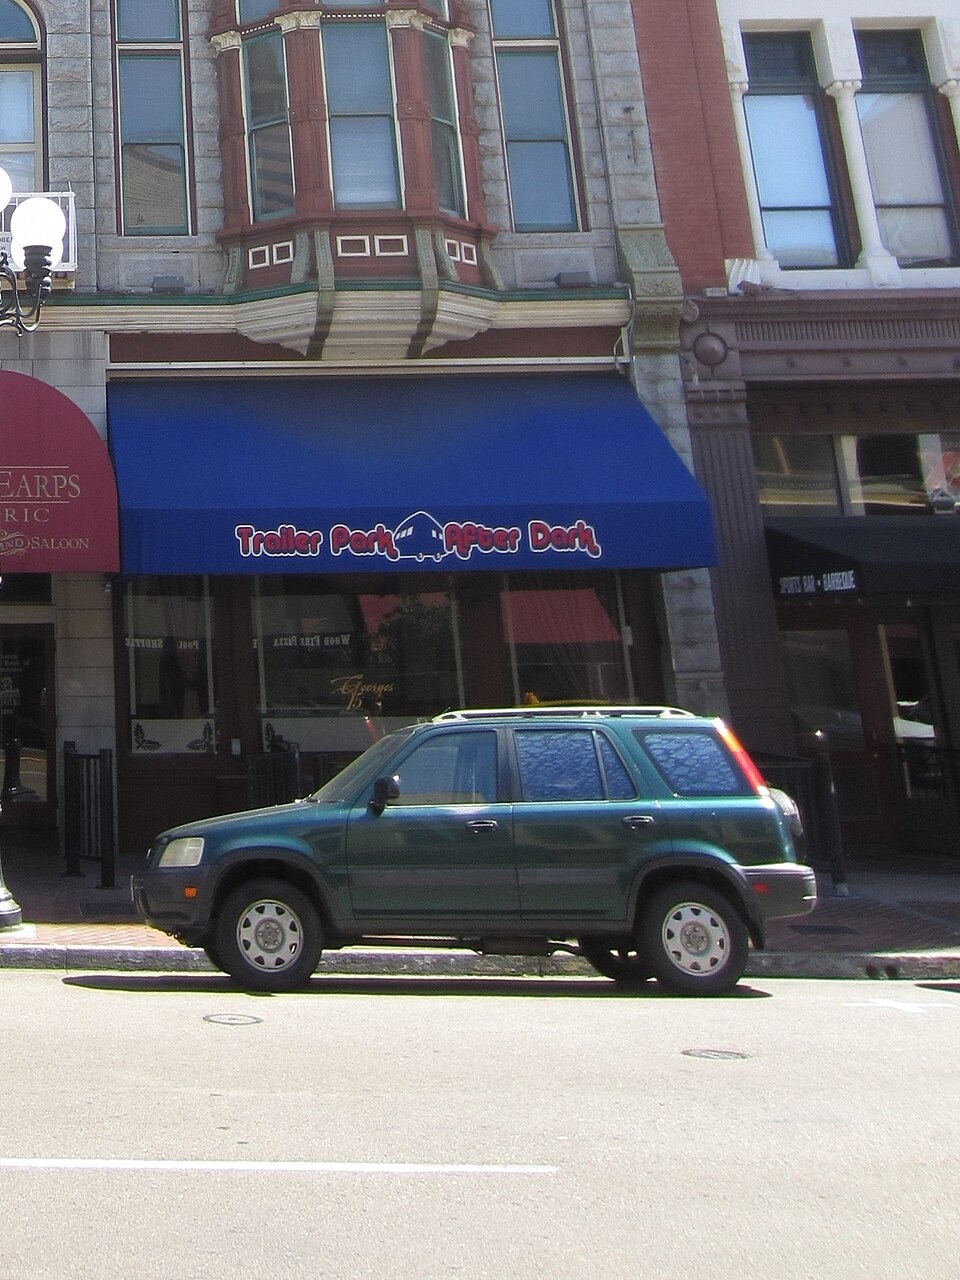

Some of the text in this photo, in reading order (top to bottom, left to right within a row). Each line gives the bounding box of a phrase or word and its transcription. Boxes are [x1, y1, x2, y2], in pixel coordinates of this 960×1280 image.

[31, 536, 90, 550] SALOON
[234, 519, 602, 562] Trailer Park After Dark
